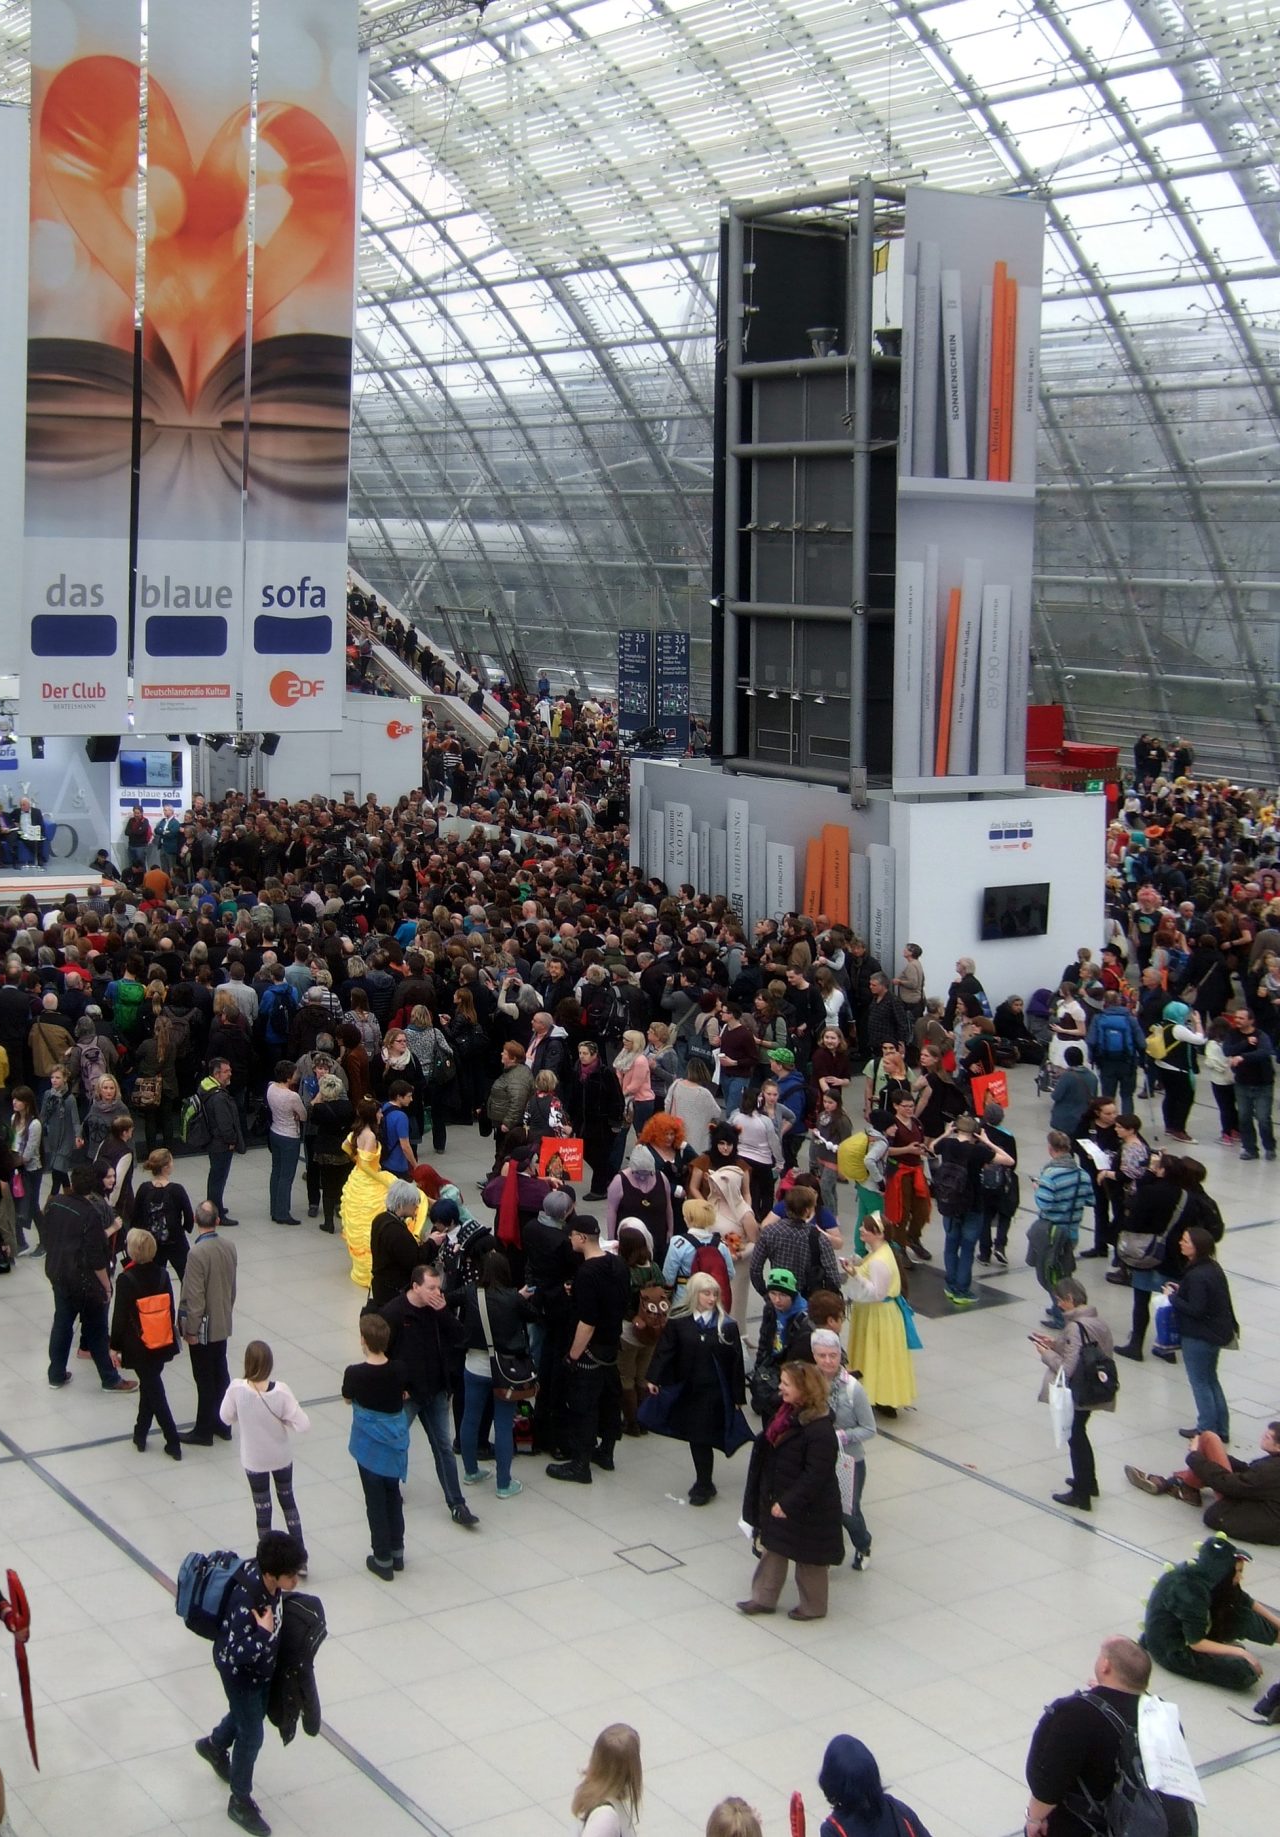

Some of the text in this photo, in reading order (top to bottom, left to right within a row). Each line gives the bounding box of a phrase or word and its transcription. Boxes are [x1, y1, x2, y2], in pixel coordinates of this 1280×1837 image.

[949, 334, 959, 421] SONNENSCHEIN
[991, 408, 1001, 454] Aberland
[46, 573, 326, 609] das blaue sofa
[635, 633, 645, 643] 3,5
[675, 634, 686, 644] 3,5
[675, 645, 685, 655] 2,4
[42, 681, 106, 699] Der Club
[986, 656, 1001, 710] 89/90
[143, 686, 228, 698] Deutschlandradio Kultur
[52, 703, 97, 711] BERTELSMANN
[121, 789, 181, 798] das blaue sofa
[667, 810, 675, 865] Jan Assmann
[676, 810, 684, 866] EXODUS
[733, 811, 742, 888] VERHEISSUNG
[873, 908, 882, 937] Ridder
[874, 939, 882, 950] de
[559, 1146, 578, 1154] Bonjour
[563, 1152, 581, 1162] Leipzig!
